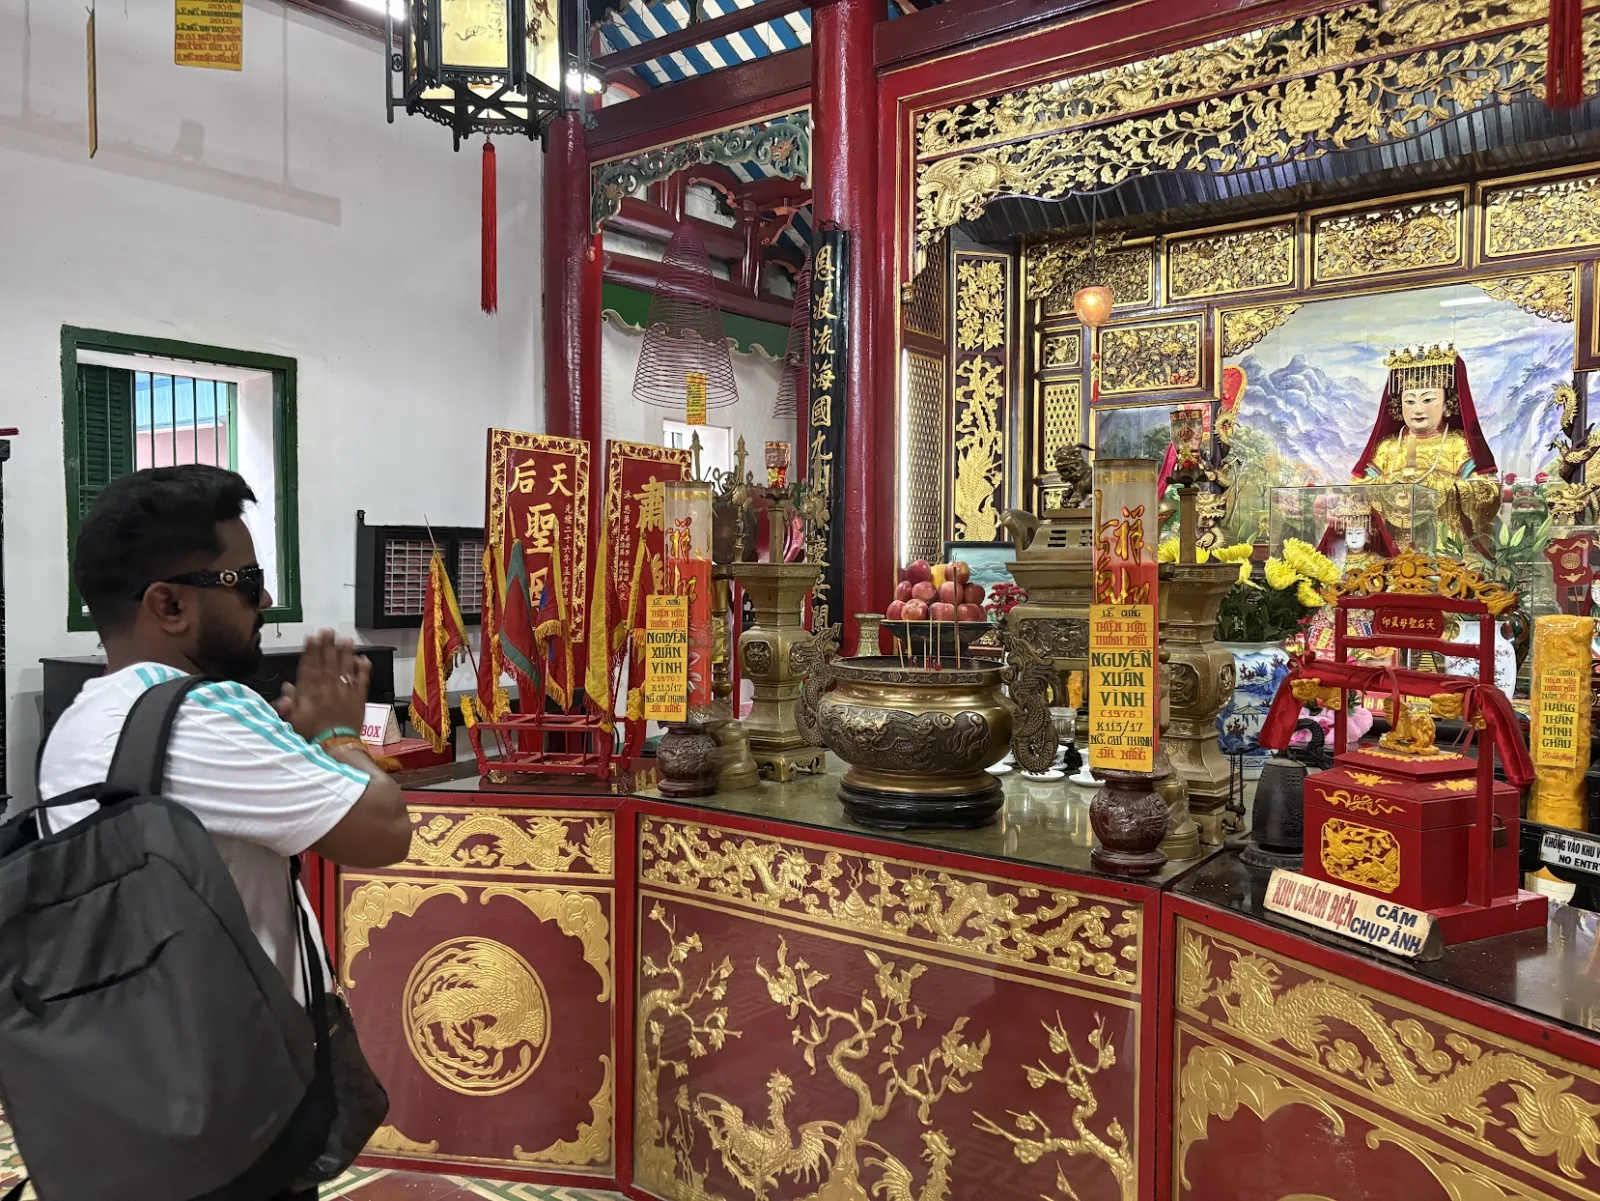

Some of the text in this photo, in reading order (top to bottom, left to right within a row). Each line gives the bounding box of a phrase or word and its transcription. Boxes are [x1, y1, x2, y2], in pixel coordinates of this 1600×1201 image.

[651, 644, 682, 659] XUÂN
[1091, 649, 1153, 668] NGUYỄN
[1099, 668, 1145, 686] XUÂN
[360, 724, 382, 738] BOX
[1096, 721, 1144, 736] K113/17
[1581, 844, 1596, 858] KHU
[1558, 854, 1600, 872] NO ENTR
[1272, 877, 1295, 908] KHU
[1350, 917, 1422, 954] CHỤP ẢNH
